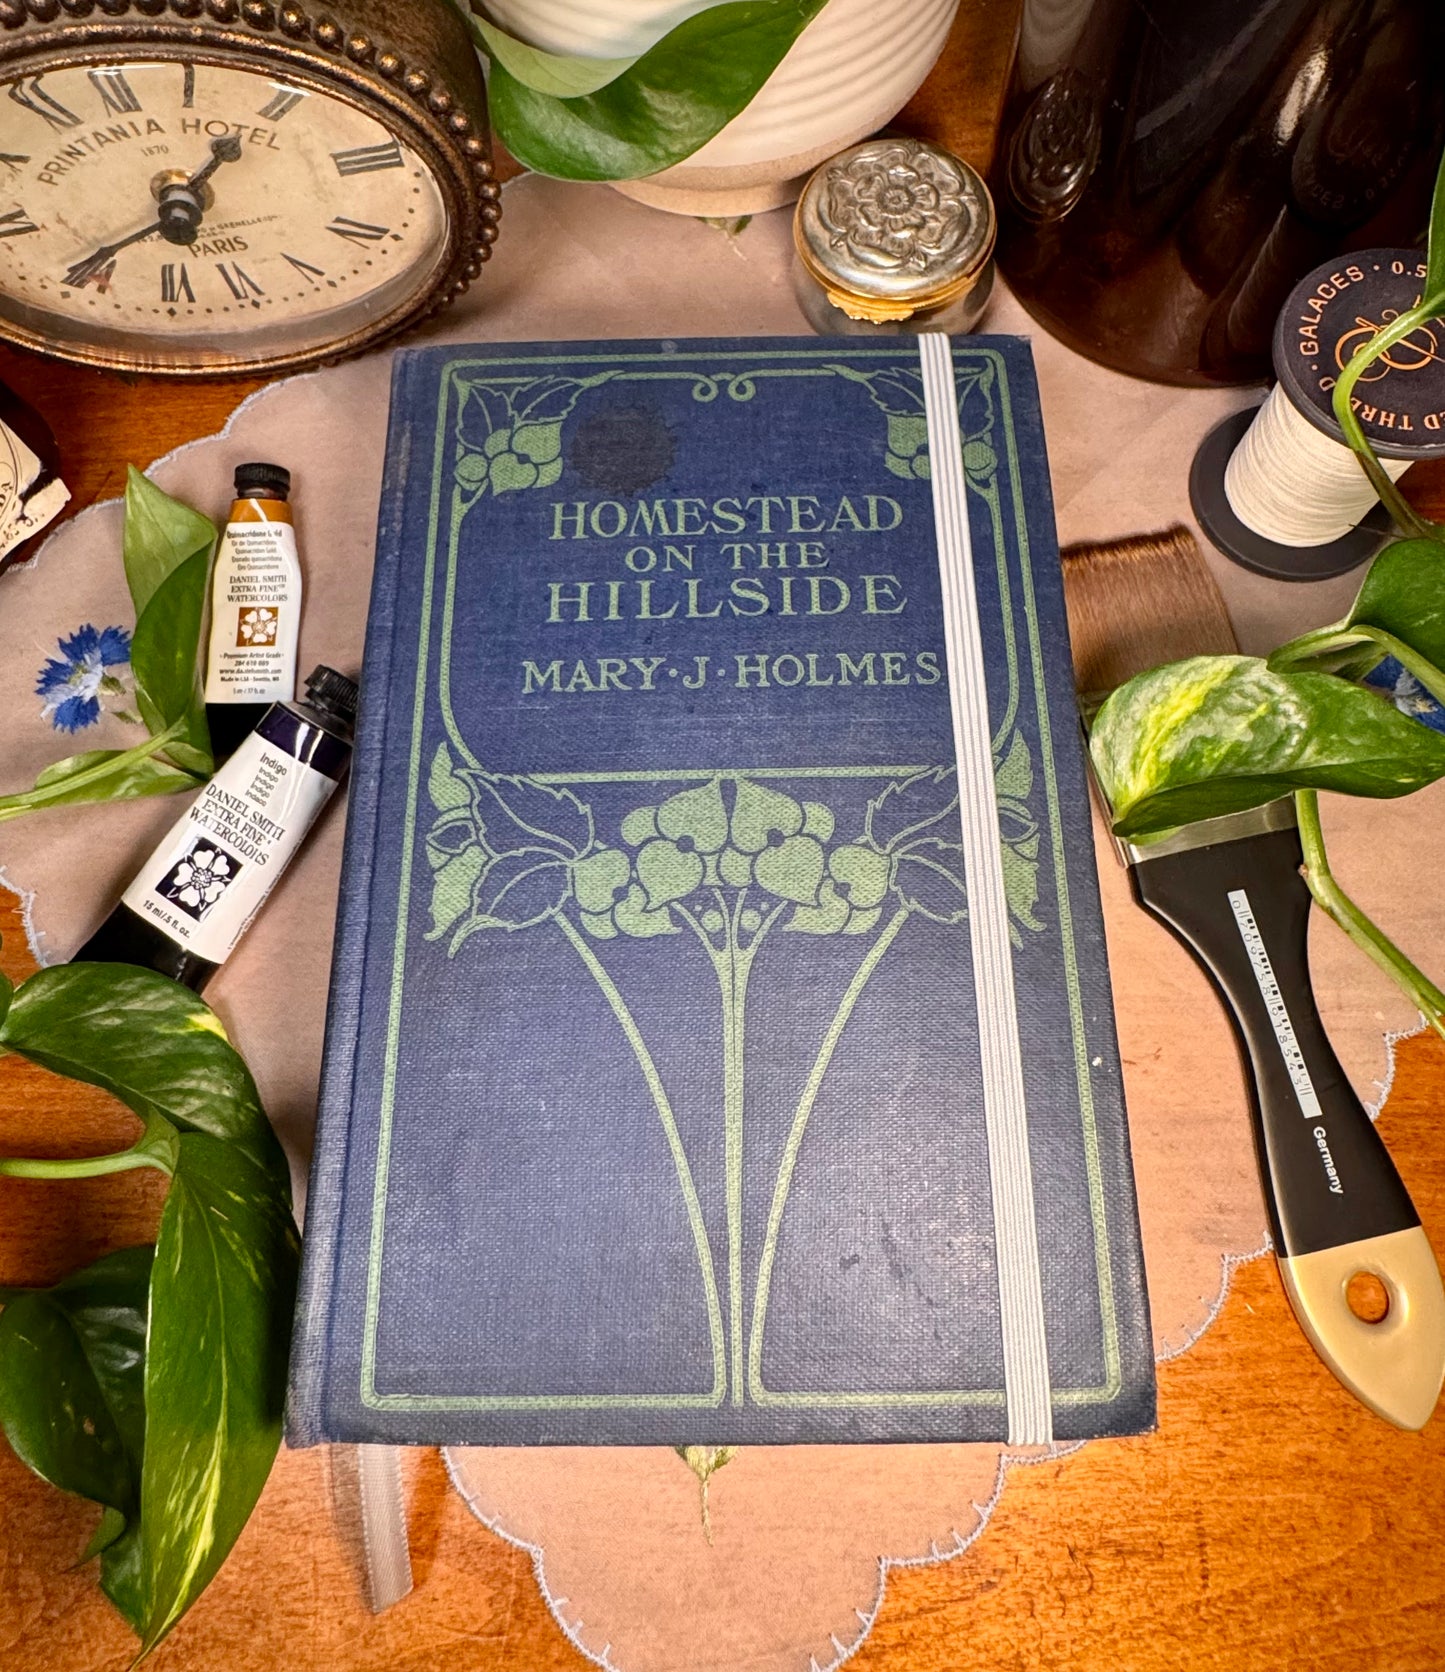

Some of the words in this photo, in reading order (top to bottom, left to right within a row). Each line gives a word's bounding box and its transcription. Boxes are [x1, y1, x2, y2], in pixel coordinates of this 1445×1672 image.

[37, 118, 165, 186] PRINTANIA
[181, 118, 281, 151] HOTEL
[141, 145, 169, 157] 1870
[187, 235, 249, 259] PARIS
[1299, 265, 1365, 356] GALACES
[1319, 376, 1414, 432] THRED
[548, 494, 904, 541] HOMESTEAD
[625, 544, 698, 573] ON
[720, 541, 831, 570] THE
[229, 575, 262, 584] DANIEL
[262, 575, 287, 583] SMITH
[231, 585, 257, 593] EXTRA
[227, 594, 288, 602] WATERCOLORS
[546, 574, 909, 623] HILLSIDE
[259, 767, 279, 783] Indigo
[260, 752, 288, 776] Indigo
[254, 774, 275, 791] Indigo
[201, 798, 243, 829] EXTRA
[205, 783, 251, 818] DANIEL
[142, 900, 151, 910] 15
[1312, 1125, 1345, 1196] Germany
